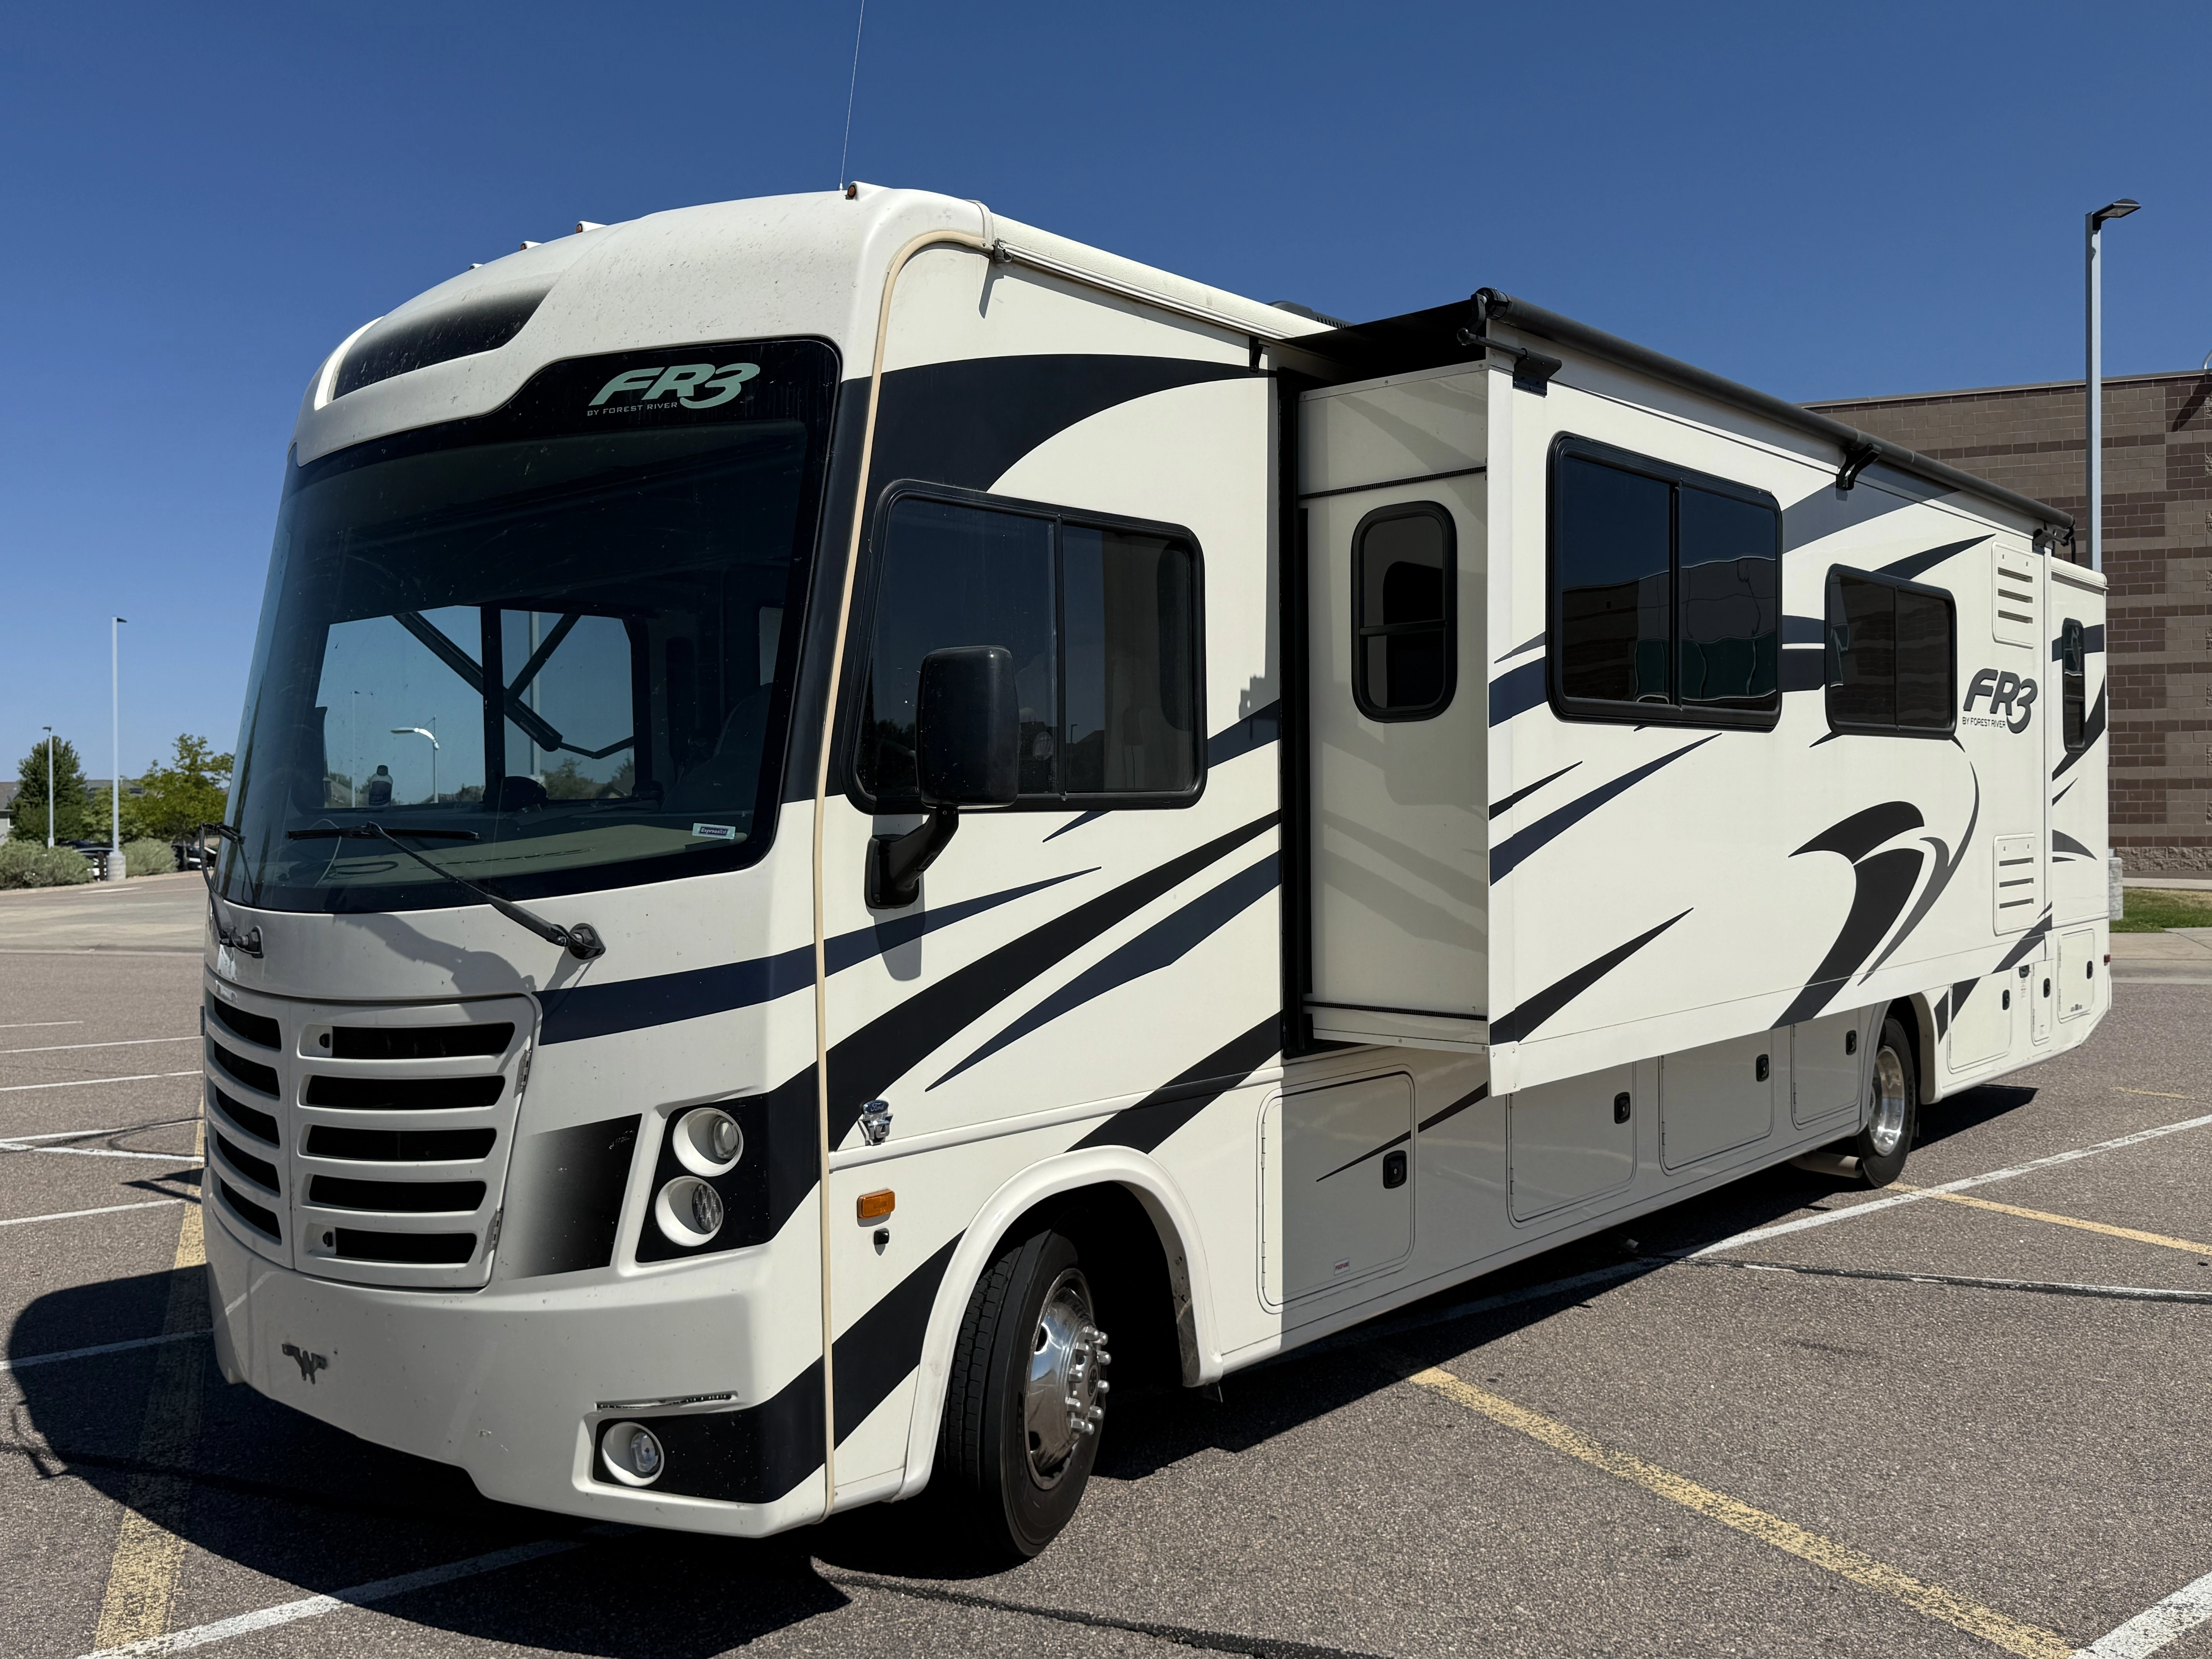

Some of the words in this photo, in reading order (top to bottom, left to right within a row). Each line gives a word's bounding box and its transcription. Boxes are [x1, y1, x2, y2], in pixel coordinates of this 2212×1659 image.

[588, 362, 761, 409] FR3
[603, 405, 643, 414] FOREST
[647, 402, 678, 410] RIVER
[1963, 668, 2038, 734] FR3
[1962, 716, 1970, 725] BY
[1970, 717, 1990, 727] FOREST
[1991, 719, 2006, 728] RIVER
[871, 1103, 884, 1111] Ford
